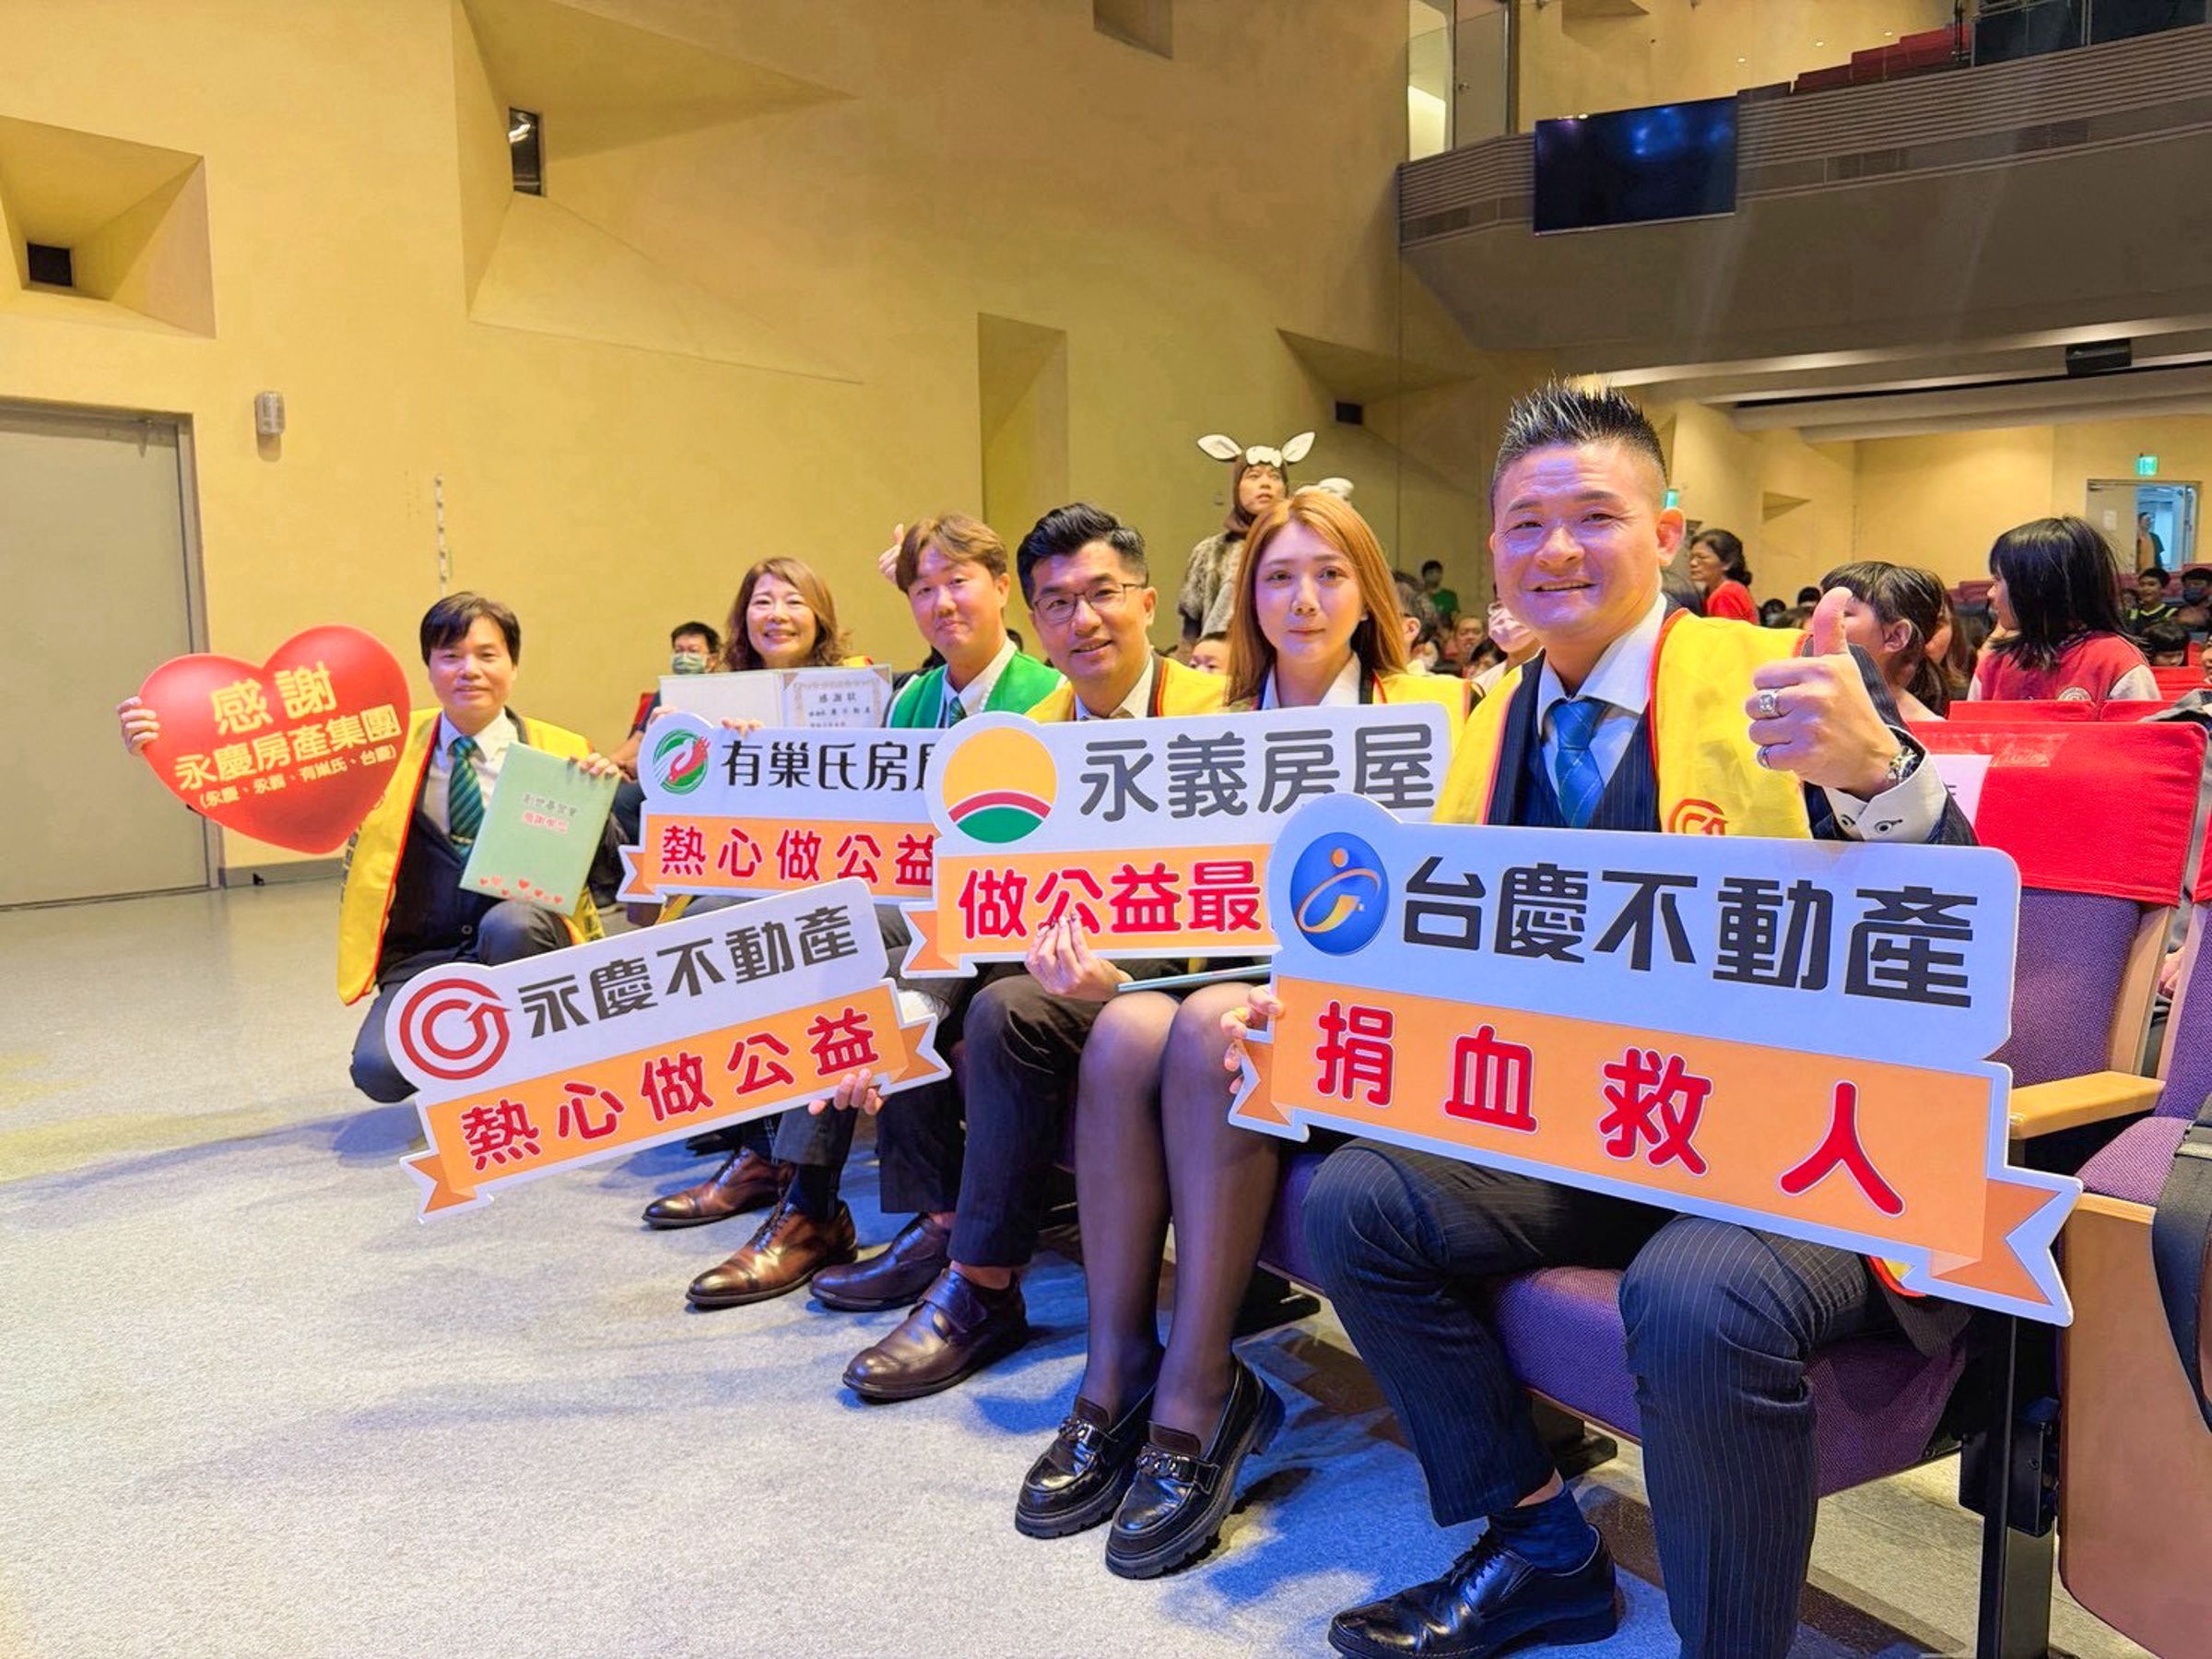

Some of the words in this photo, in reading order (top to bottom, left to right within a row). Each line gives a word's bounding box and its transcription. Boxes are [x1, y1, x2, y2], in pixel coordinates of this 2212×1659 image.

[210, 660, 338, 736] 感謝
[174, 703, 403, 791] 永慶房產集團
[720, 739, 935, 793] 有巢氏房
[1079, 724, 1435, 822] 永義房屋
[661, 824, 935, 886] 熱心做公益
[958, 860, 1262, 940] 做公益最
[518, 904, 859, 1040] 永慶不動產
[1403, 855, 1978, 1009] 台慶不動產
[460, 1006, 880, 1172] 熱心做公益
[1315, 1000, 1905, 1218] 捐血救人
